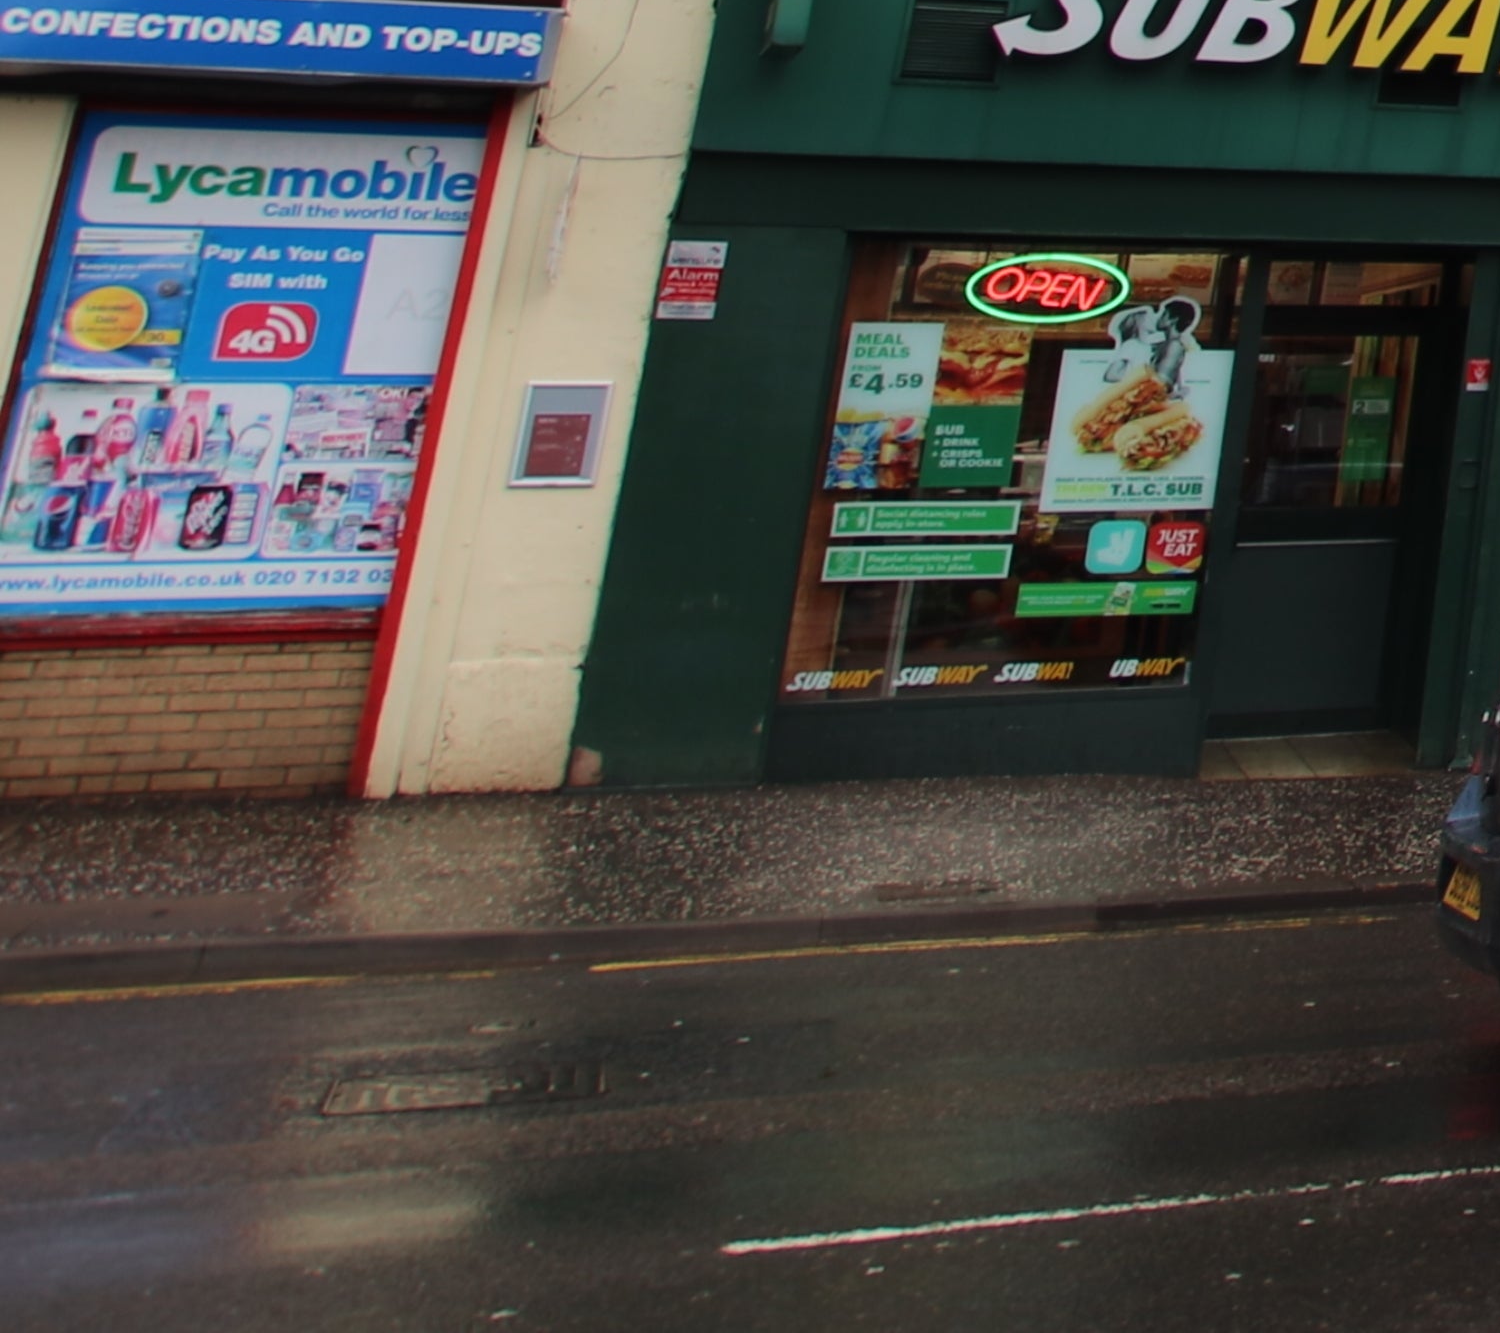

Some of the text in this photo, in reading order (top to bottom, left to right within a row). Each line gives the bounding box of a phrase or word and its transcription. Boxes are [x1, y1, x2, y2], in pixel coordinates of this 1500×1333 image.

[1, 7, 542, 57] CONFECTIONS AND TOP-UPS
[113, 151, 477, 203] Lycamobile
[262, 202, 472, 223] Call the world for less
[204, 245, 364, 264] Pay As You Go
[228, 273, 328, 289] SIM with
[669, 268, 719, 280] Alarm
[985, 266, 1105, 312] OPEN
[228, 329, 276, 354] 4G
[855, 333, 904, 345] MEAL
[853, 347, 910, 358] DEALS
[851, 364, 882, 372] FROM
[848, 373, 923, 394] £4.59
[936, 425, 964, 435] SUB
[942, 438, 979, 447] DRINK
[941, 450, 982, 458] CRISPS
[939, 459, 1003, 468] OR COOKIE
[1110, 483, 1203, 496] T.L.C. SUB
[1157, 529, 1199, 545] JUST
[1164, 543, 1197, 557] EAT
[255, 571, 296, 586] 020
[305, 570, 360, 586] 7132
[786, 669, 884, 691] SUBWAY
[893, 665, 987, 687] SUBWAY
